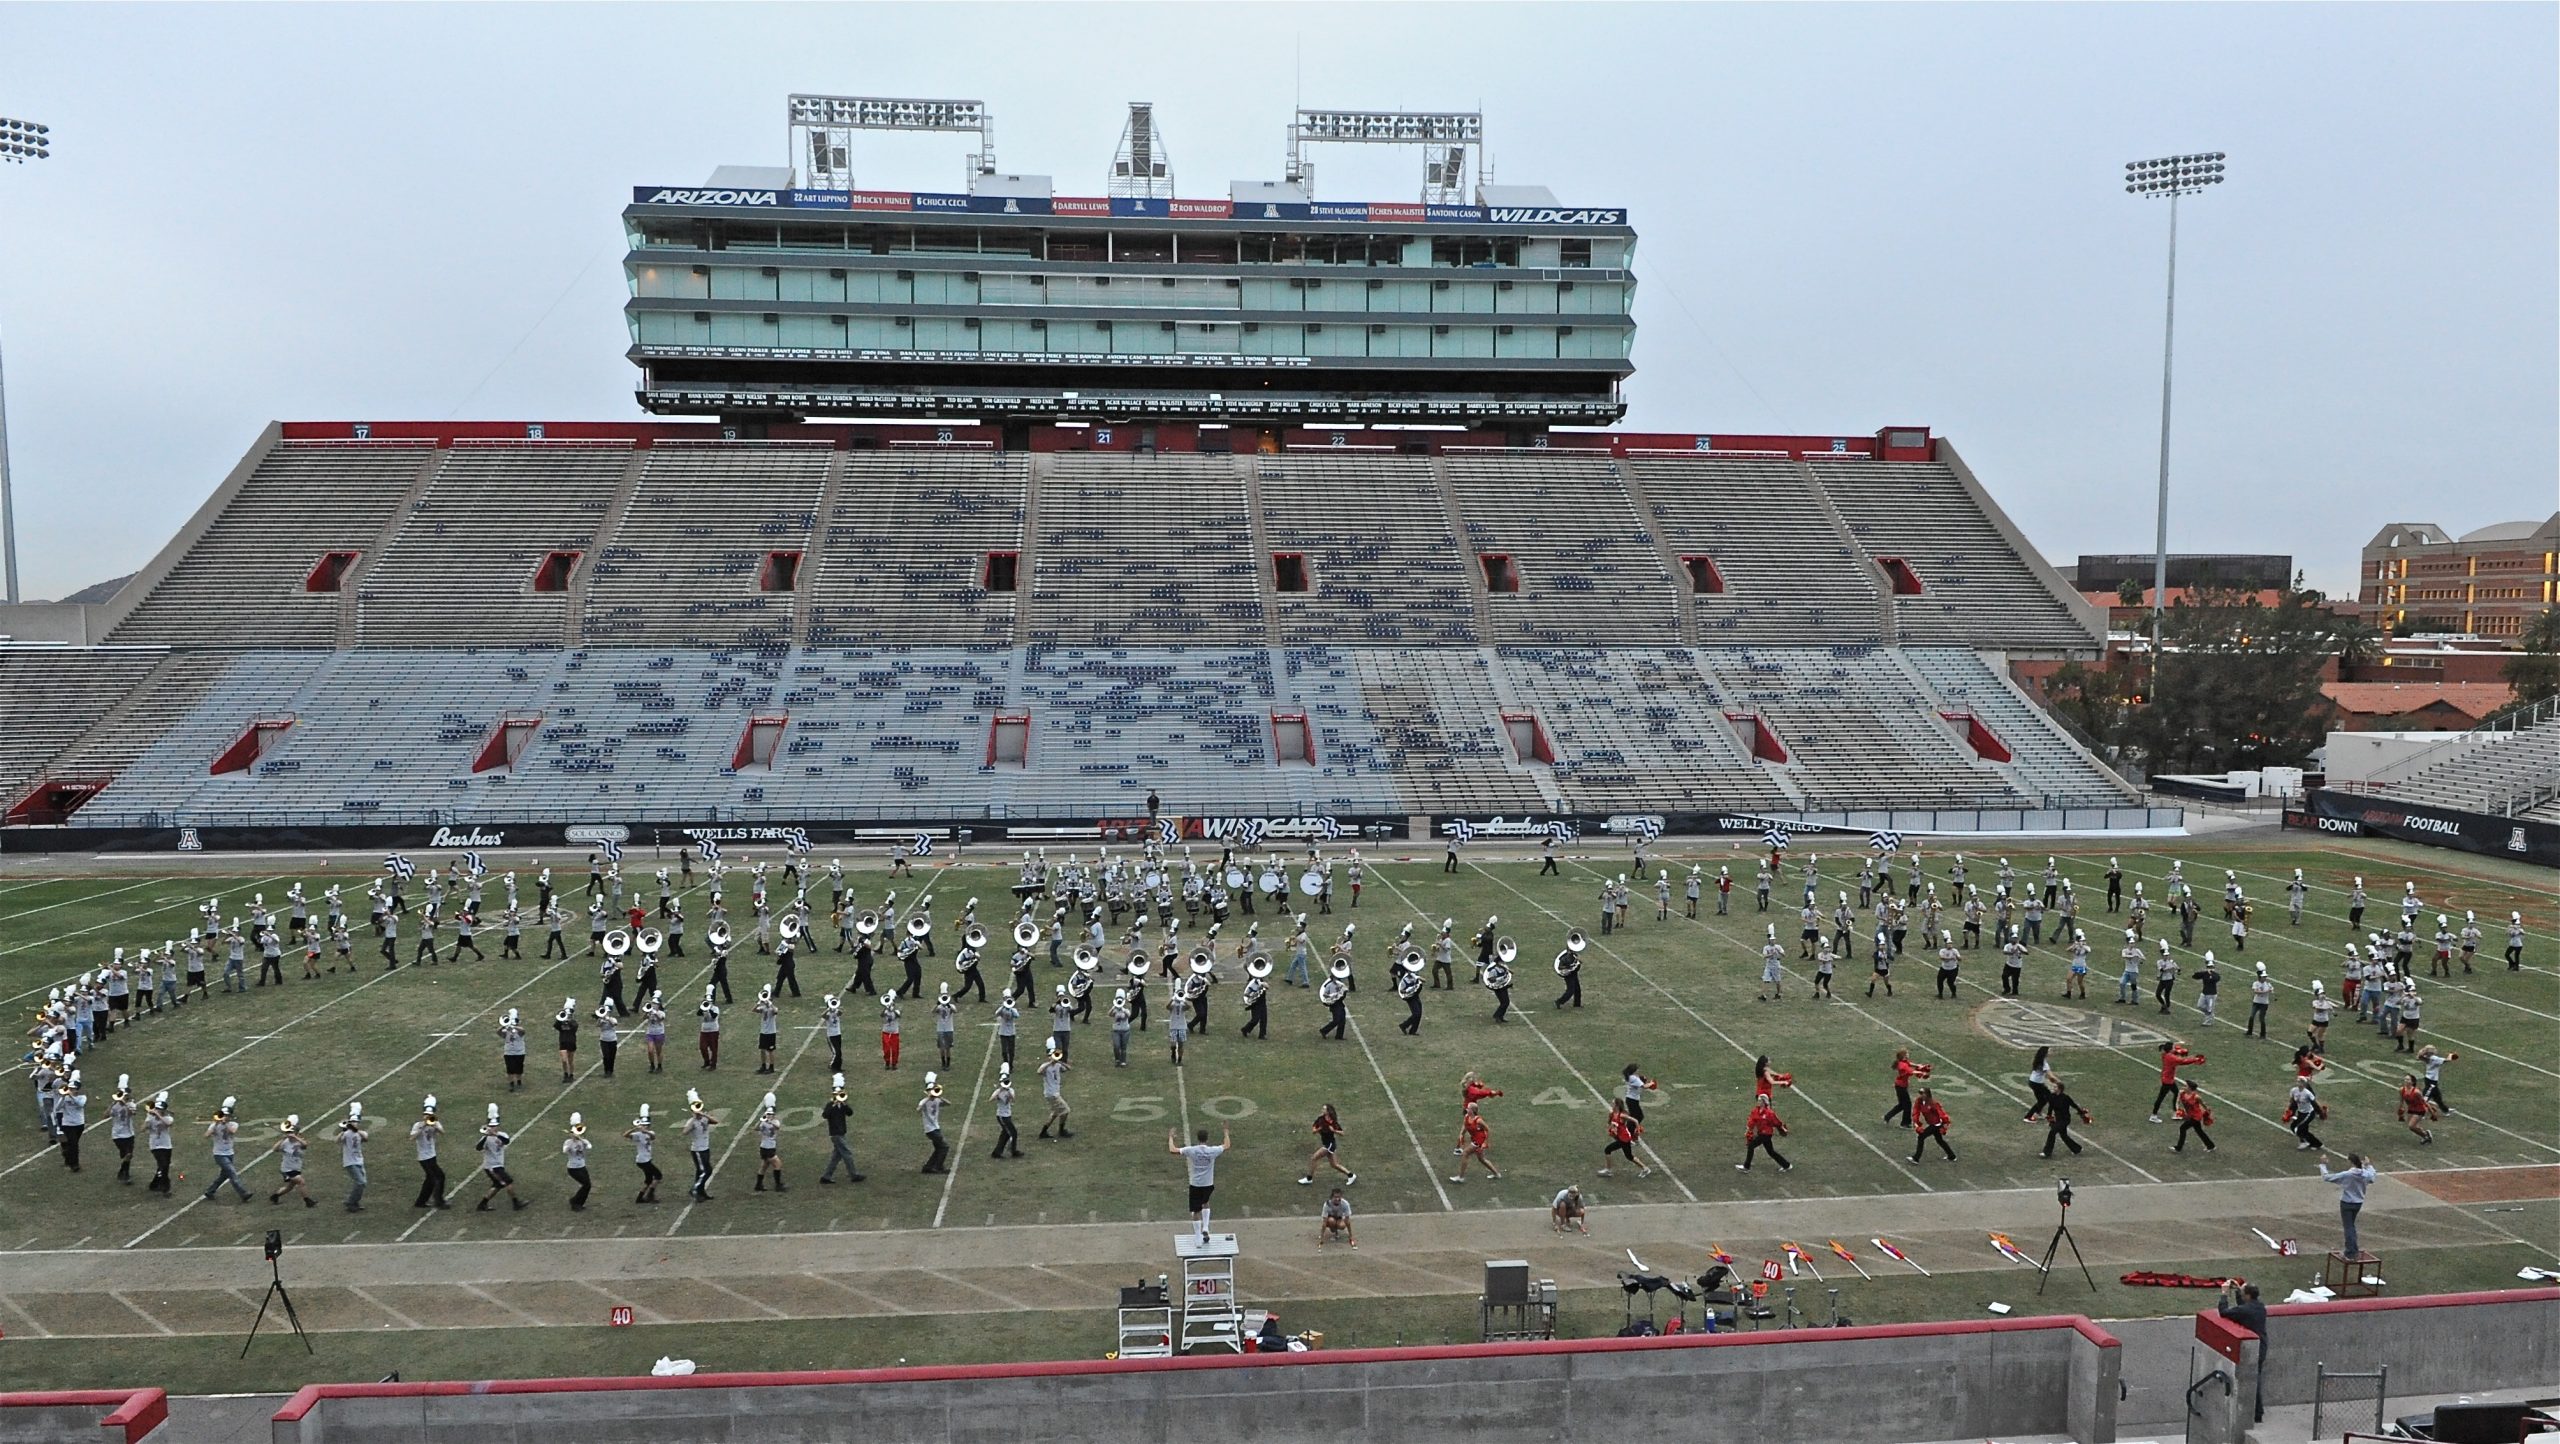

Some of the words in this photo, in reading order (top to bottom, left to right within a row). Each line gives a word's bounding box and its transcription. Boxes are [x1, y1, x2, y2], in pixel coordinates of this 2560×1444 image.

[648, 190, 776, 205] ARIZONA
[793, 193, 801, 201] 22
[817, 195, 847, 203] LUPPINO
[885, 197, 911, 205] HUNLEY
[923, 198, 947, 206] CHUCK
[948, 199, 968, 207] CECIL
[1052, 201, 1057, 209] 4
[1089, 203, 1109, 211] LEWIS
[1459, 210, 1481, 218] CASON
[1490, 208, 1619, 224] WILDCATS
[356, 429, 368, 438] 17
[528, 430, 542, 439] 18
[724, 430, 736, 440] 19
[938, 432, 953, 441] 20
[1098, 433, 1110, 443] 21
[1332, 436, 1345, 445] 22
[1535, 439, 1547, 448] 23
[1697, 442, 1710, 451] 24
[1832, 444, 1845, 453] 25
[1718, 818, 1770, 829] WELLS
[2287, 815, 2317, 828] BEAR
[2318, 818, 2358, 834] DOWN
[2403, 815, 2460, 836] FOOTBALL
[430, 827, 504, 847] Bashas'
[571, 830, 588, 838] SOL
[589, 830, 624, 839] CASINOS
[691, 828, 747, 840] WELLS
[751, 828, 806, 839] FARGO
[178, 828, 202, 851] A
[2508, 827, 2527, 852] A
[1109, 1096, 1258, 1122] 50
[2283, 1240, 2297, 1256] 30
[1764, 1261, 1778, 1279] 40
[1199, 1279, 1215, 1294] 50
[613, 1308, 630, 1324] 40
